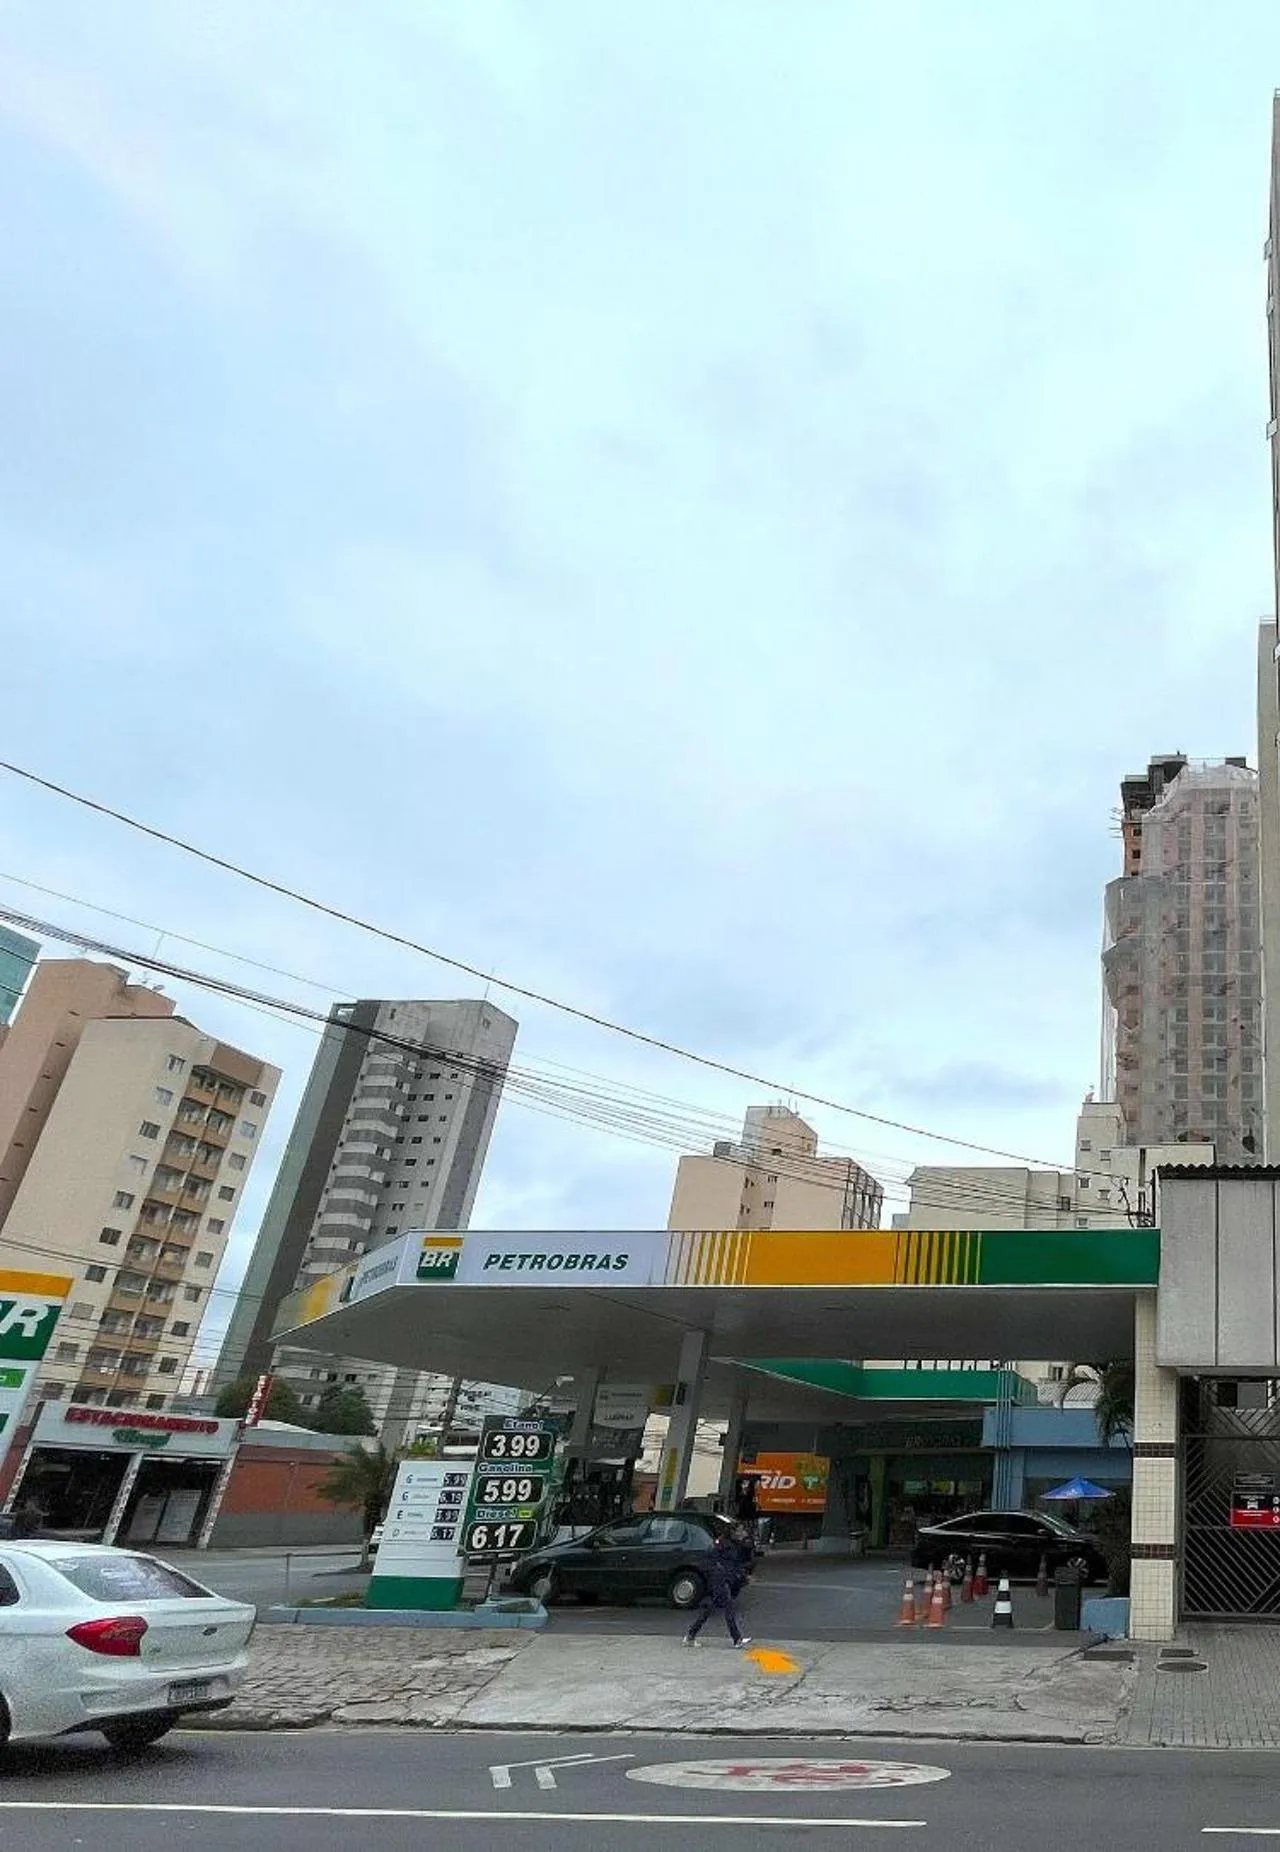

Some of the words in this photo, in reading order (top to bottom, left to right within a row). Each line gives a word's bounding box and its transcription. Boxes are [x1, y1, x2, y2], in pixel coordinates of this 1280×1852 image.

[420, 1251, 454, 1268] BR
[482, 1253, 629, 1271] PETROBRAS
[0, 1301, 49, 1337] R
[491, 1434, 540, 1457] 3.99
[472, 1524, 524, 1549] 6.17
